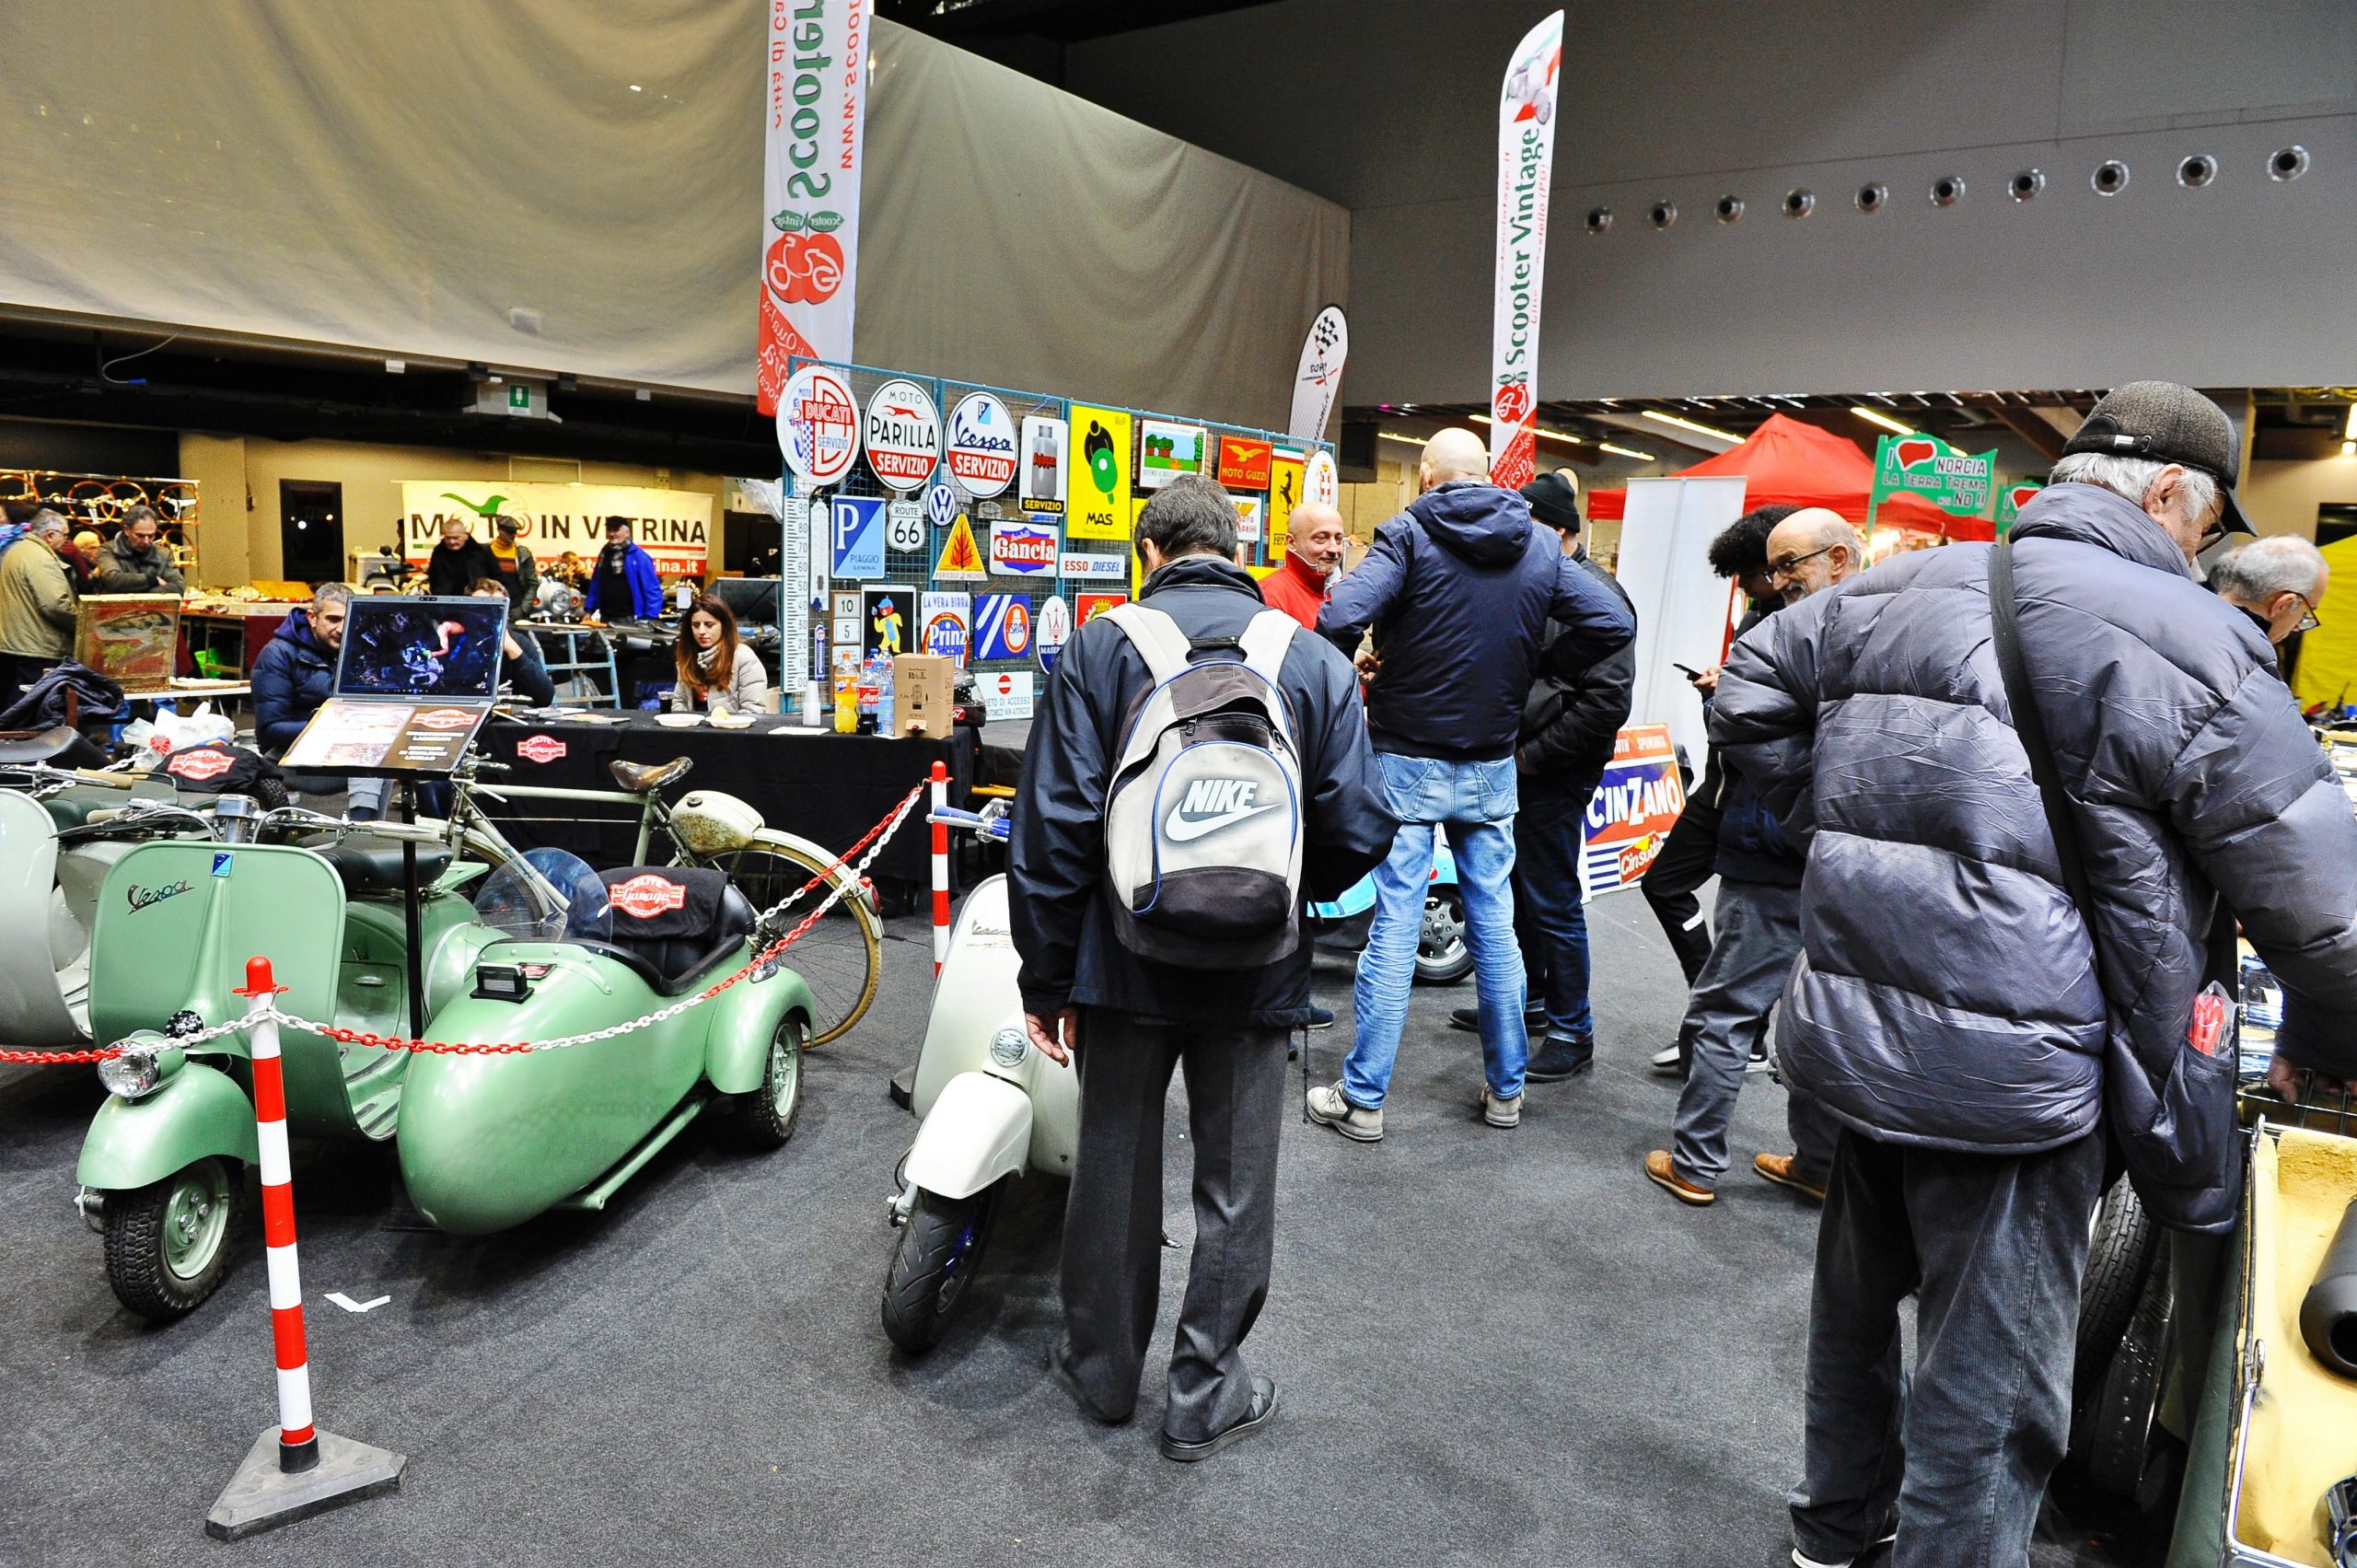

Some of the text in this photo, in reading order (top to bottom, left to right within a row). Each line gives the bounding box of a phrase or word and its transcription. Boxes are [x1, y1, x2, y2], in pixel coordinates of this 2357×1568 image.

[1510, 128, 1544, 245] Vintage
[1504, 250, 1531, 366] Scooter
[889, 390, 923, 405] MOTO
[805, 401, 851, 424] DUCATI
[870, 414, 936, 450] PARILLA
[953, 411, 1014, 452] Vespa
[818, 436, 848, 449] SERVIZIO
[876, 452, 928, 477] SERVIZIO
[954, 453, 1009, 481] SERVIZIO
[1935, 459, 1986, 476] NORCIA
[1221, 467, 1267, 482] MOTO GUZZI
[1883, 473, 1987, 491] LA TERRA TREMA
[798, 503, 807, 514] 90
[894, 505, 919, 517] ROUTE
[1024, 498, 1062, 512] SERVIZIO
[836, 503, 859, 550] P
[1086, 512, 1113, 526] MAS
[540, 514, 571, 540] IN
[582, 516, 706, 543] VTRINA
[798, 522, 807, 533] 80
[894, 519, 920, 544] 66
[798, 542, 807, 552] 70
[993, 537, 1055, 562] Gancia
[850, 554, 880, 563] PIAGGIO
[798, 562, 807, 573] 60
[1064, 560, 1120, 573] ESSO DIESEL
[798, 581, 807, 591] 50
[798, 600, 807, 611] 40
[841, 599, 853, 612] 10
[923, 596, 970, 609] LA VERA BIRRA
[798, 620, 807, 630] 30
[844, 625, 850, 639] 5
[929, 621, 967, 646] Prinz
[798, 639, 807, 650] 20
[798, 658, 807, 668] 10
[1181, 780, 1259, 813] NIKE
[1585, 776, 1681, 829] CINZANO
[127, 879, 196, 915] Vespa
[622, 887, 670, 904] Garage
